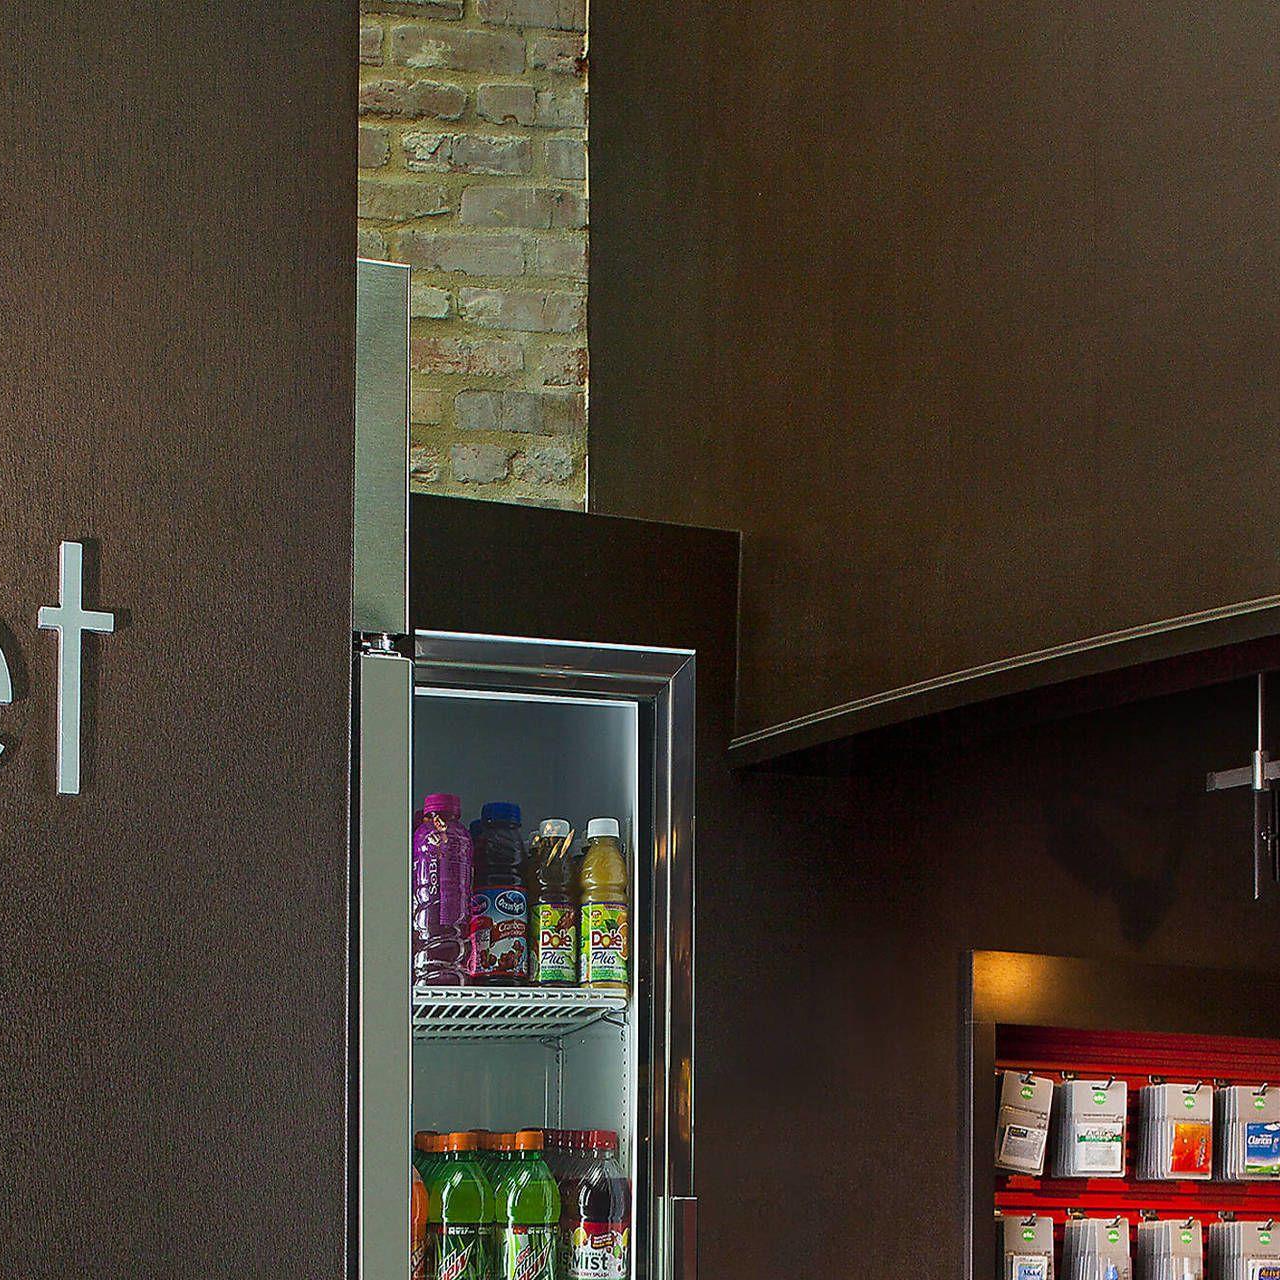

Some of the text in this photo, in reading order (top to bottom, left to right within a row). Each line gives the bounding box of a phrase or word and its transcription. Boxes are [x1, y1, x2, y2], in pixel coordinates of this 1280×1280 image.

[541, 929, 572, 948] Dole
[591, 929, 623, 948] Dole
[541, 951, 565, 965] Plus
[591, 951, 616, 965] Plus
[572, 1252, 609, 1270] Mist
